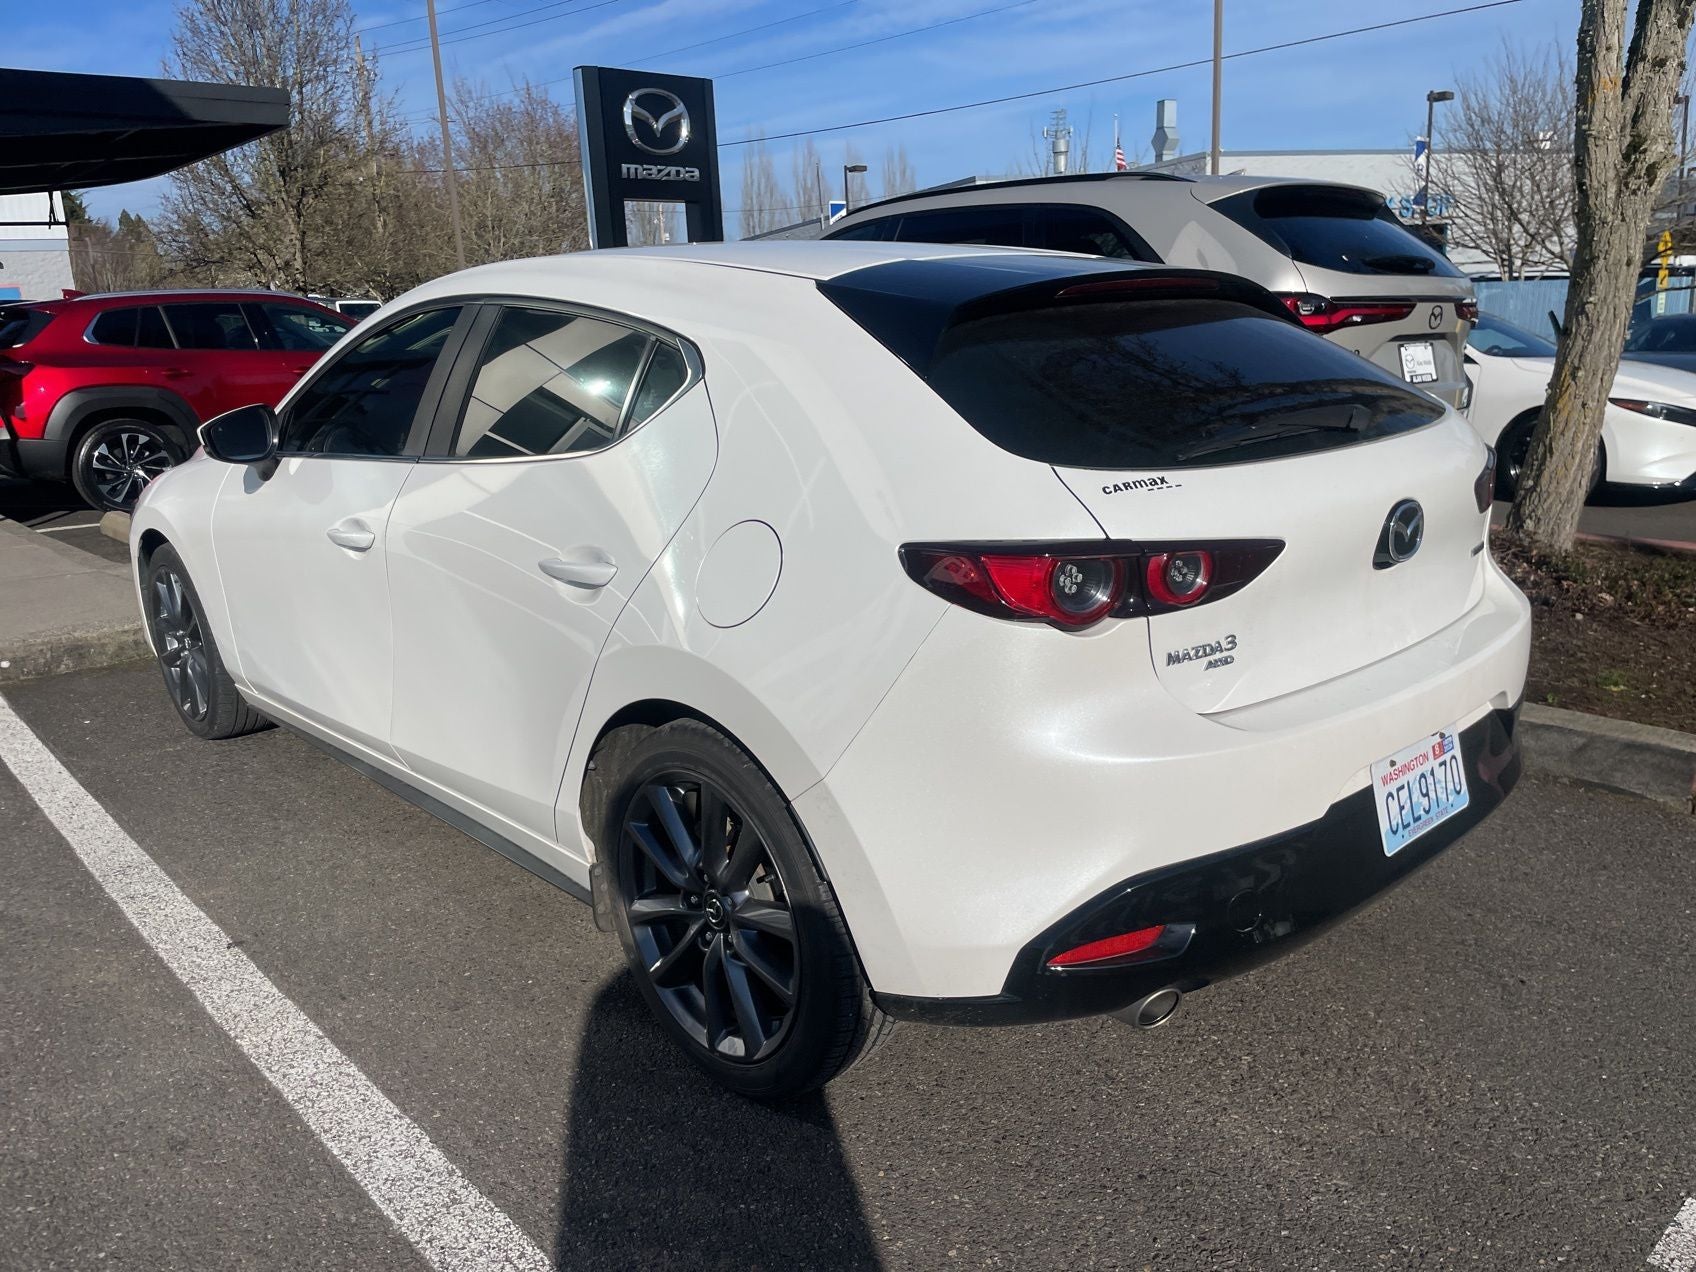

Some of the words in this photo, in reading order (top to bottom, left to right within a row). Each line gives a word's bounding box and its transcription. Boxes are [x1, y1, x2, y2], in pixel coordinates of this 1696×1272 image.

[1203, 655, 1235, 671] AWD
[1380, 751, 1429, 787] WASHINGTON
[1385, 754, 1462, 836] CEL9170
